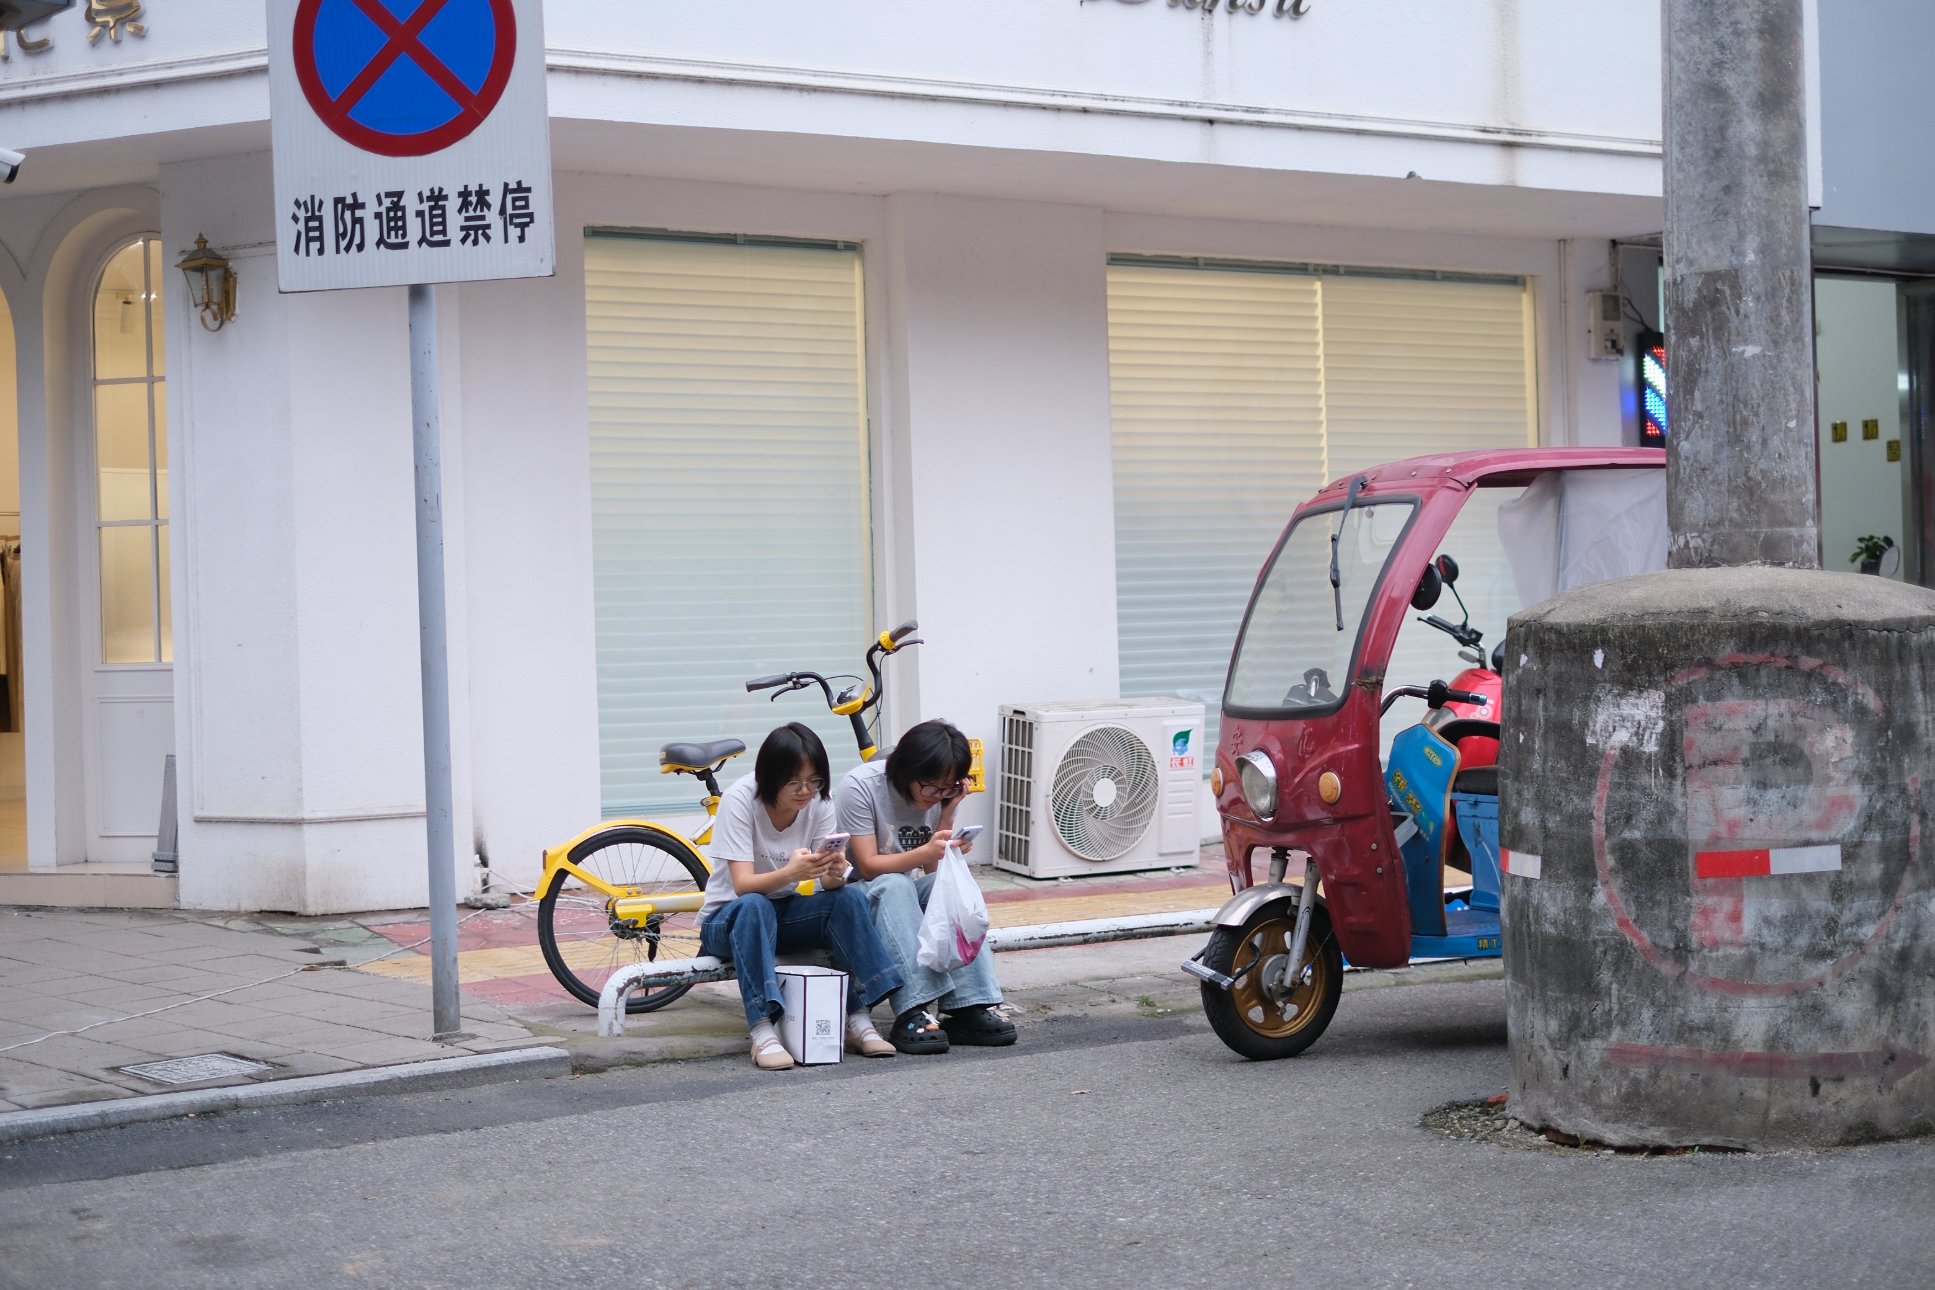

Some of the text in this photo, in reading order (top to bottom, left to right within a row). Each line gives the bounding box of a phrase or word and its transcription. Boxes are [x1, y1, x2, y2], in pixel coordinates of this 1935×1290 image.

[290, 180, 535, 257] 消防通道禁停
